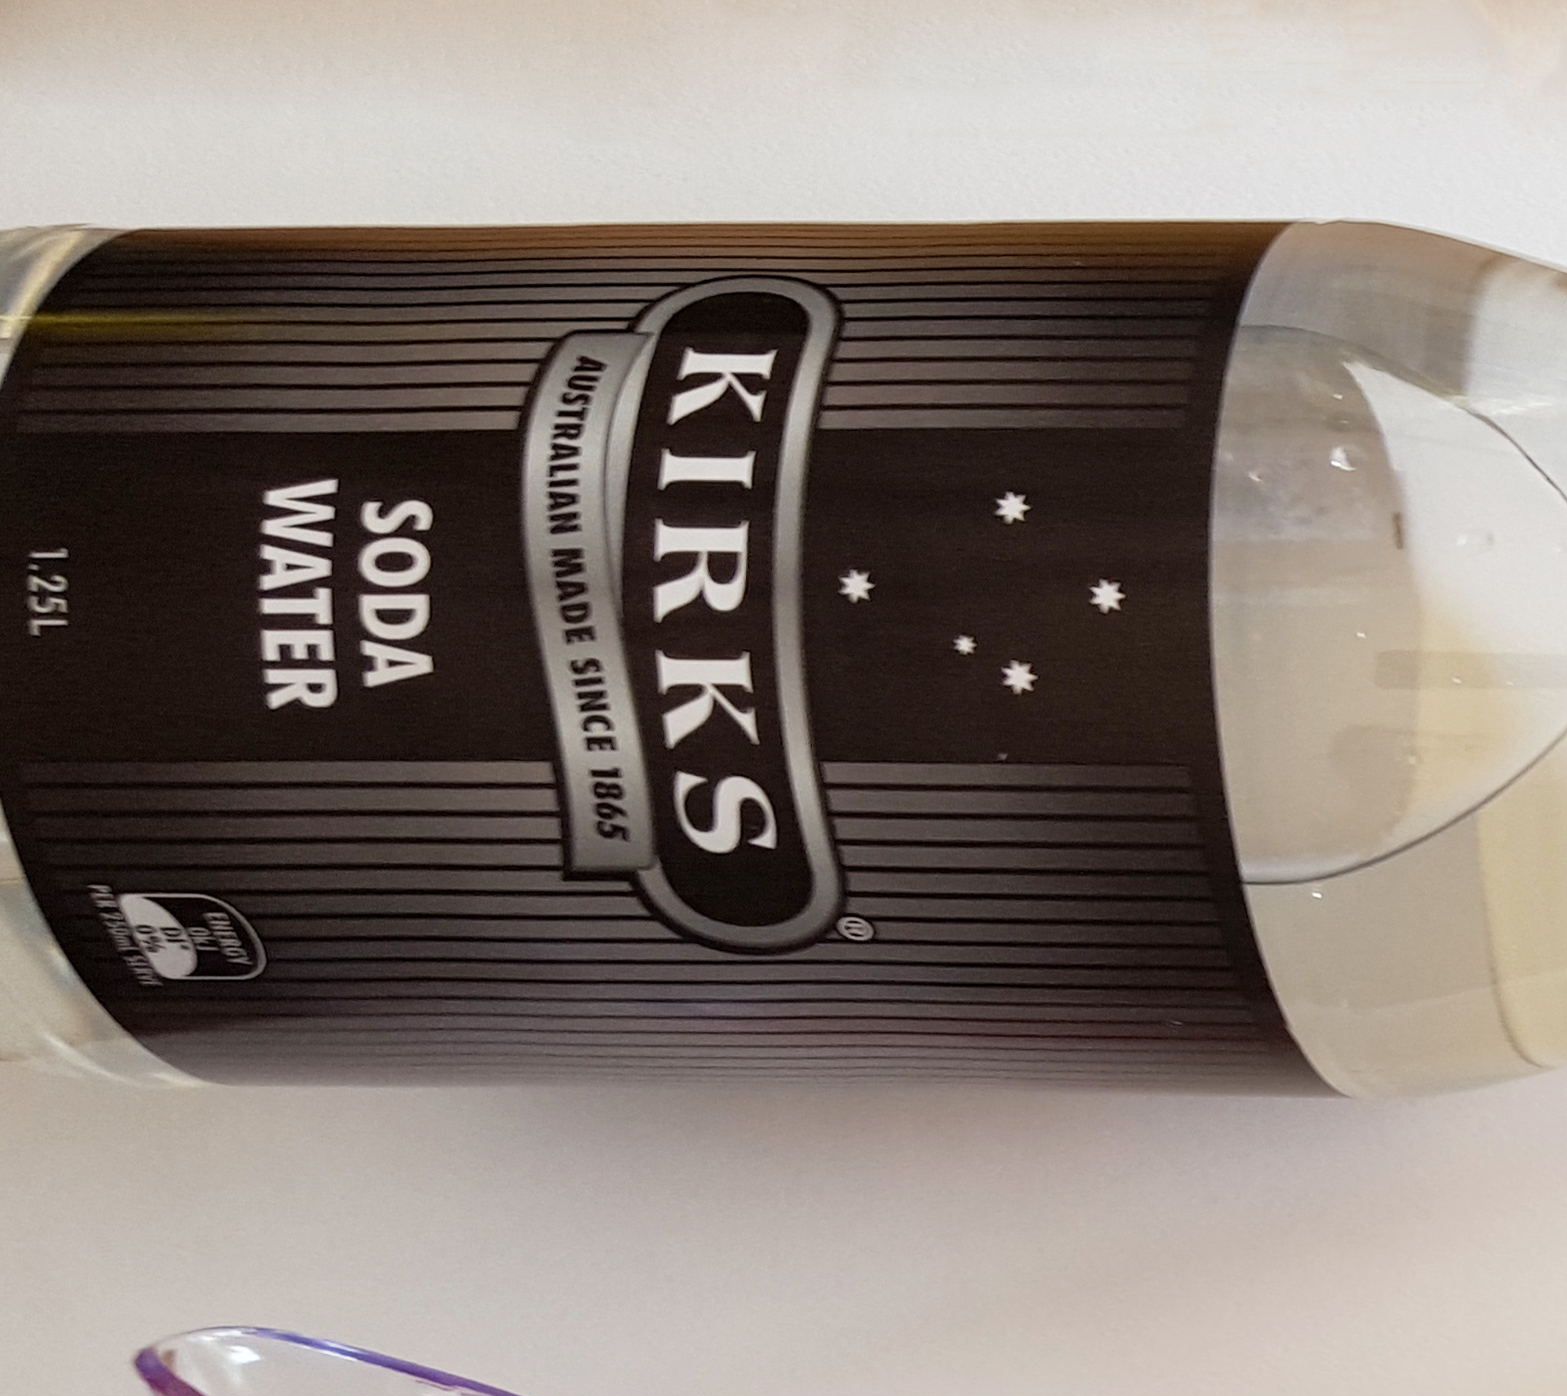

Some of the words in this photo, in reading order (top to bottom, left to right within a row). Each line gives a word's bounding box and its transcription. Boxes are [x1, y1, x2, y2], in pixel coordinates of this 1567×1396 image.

[547, 353, 608, 535] AUSTRALIAN
[27, 546, 70, 637] 1.25L
[258, 479, 339, 711] WATER
[357, 498, 434, 688] SODA
[551, 548, 596, 644] MADE
[652, 347, 779, 854] KIRKS
[568, 657, 617, 752] SINCE
[588, 764, 629, 843] 1865
[203, 911, 253, 966] ENERGY
